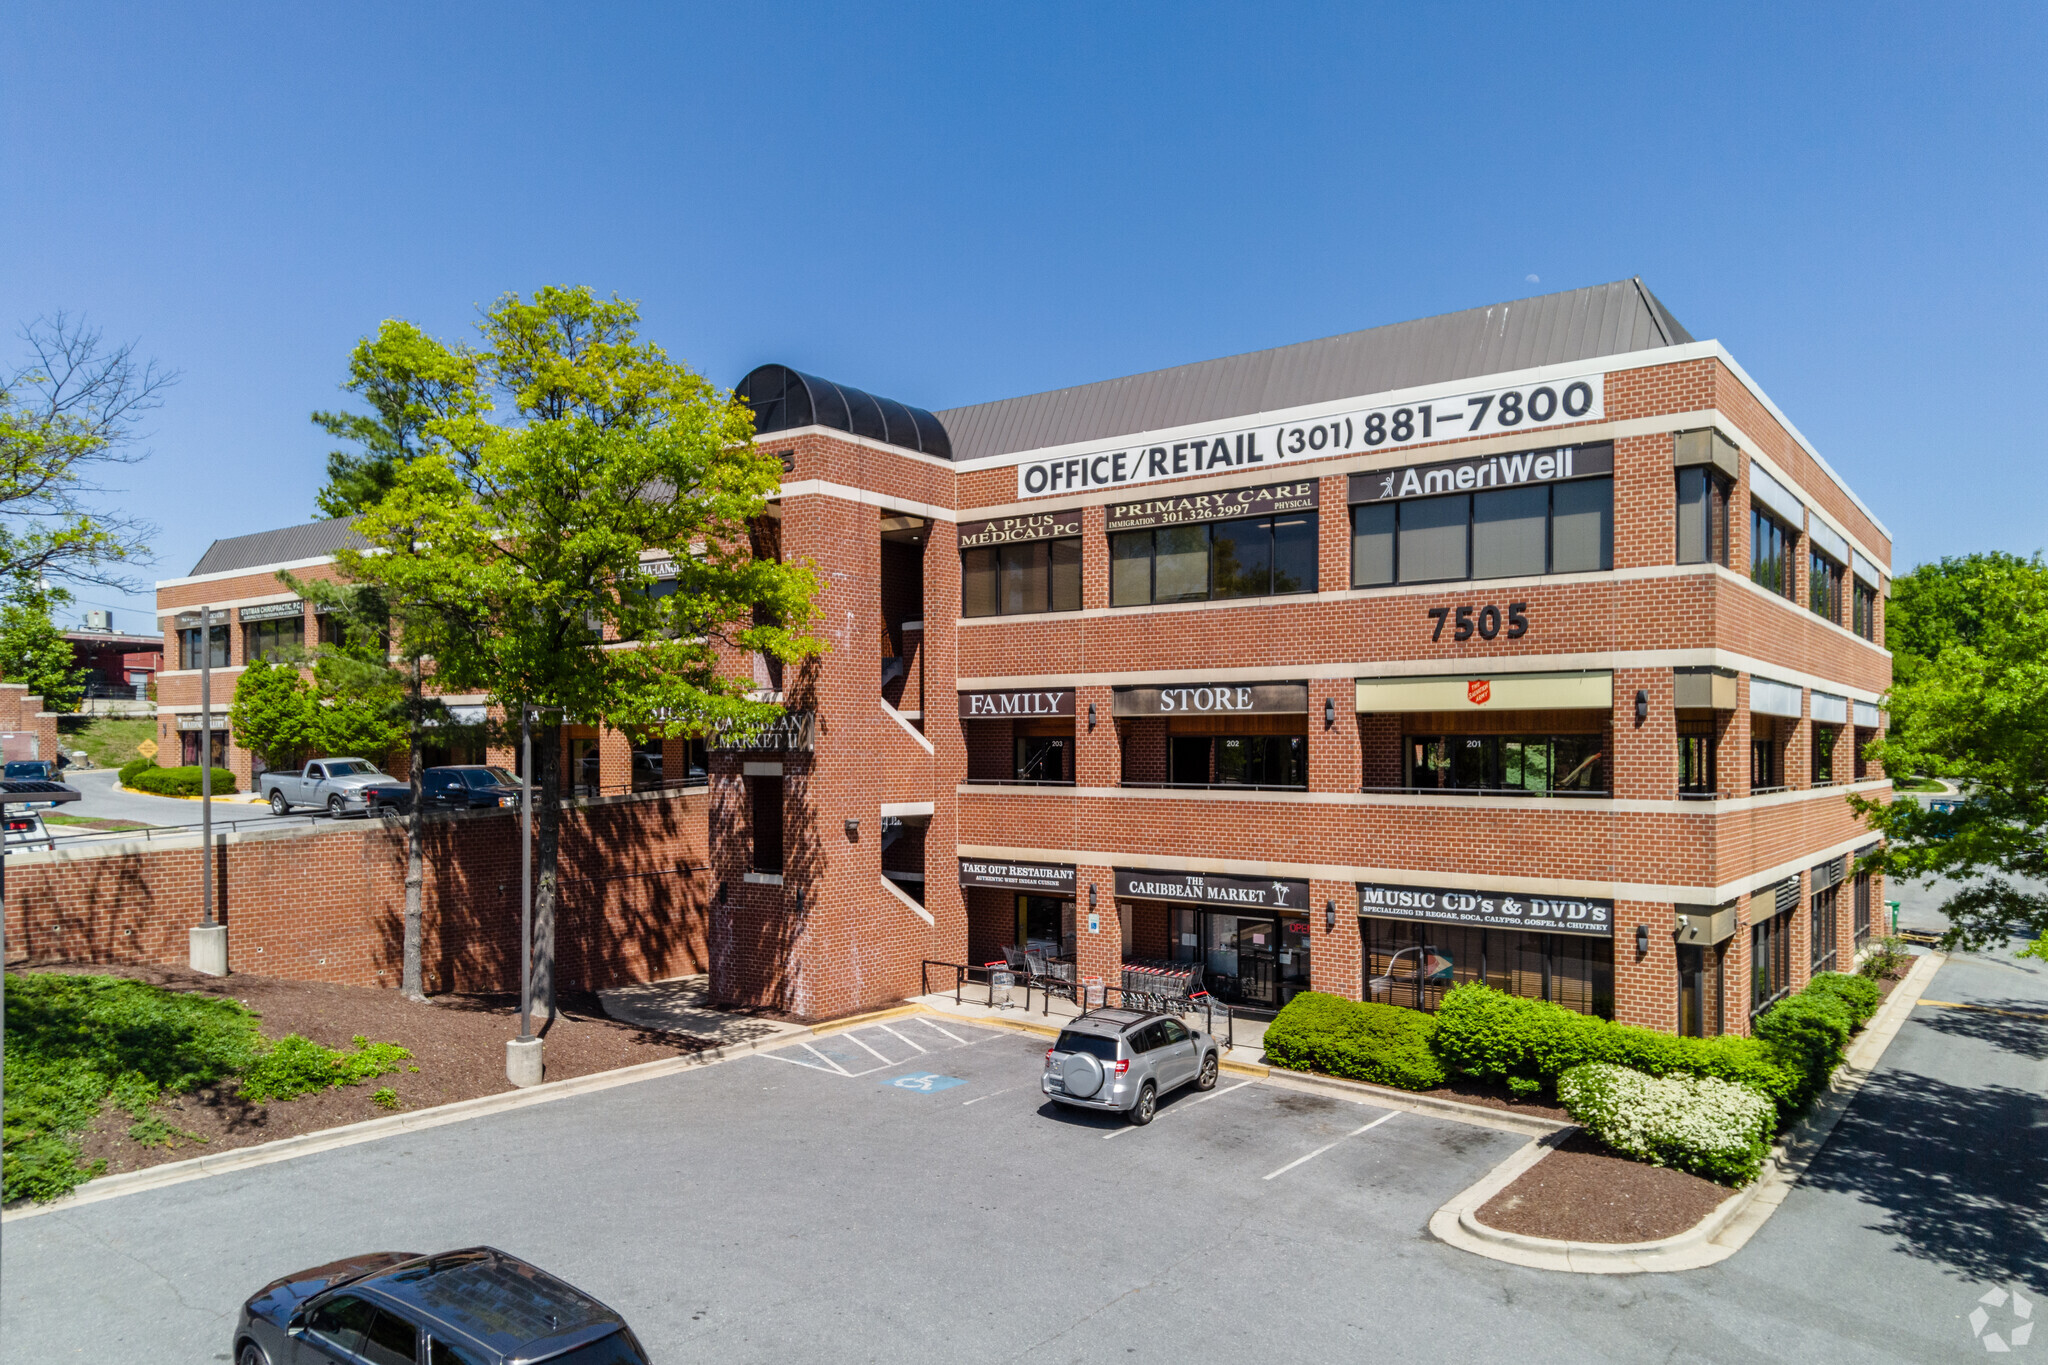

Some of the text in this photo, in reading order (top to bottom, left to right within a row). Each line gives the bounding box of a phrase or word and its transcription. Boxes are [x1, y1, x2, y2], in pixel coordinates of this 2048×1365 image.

[1024, 381, 1594, 494] OFFICE/RETAIL (301) 881-7800
[1399, 447, 1573, 497] AmeriWell
[1114, 483, 1312, 518] PRIMARY CARE
[984, 514, 1054, 533] A PLUS
[1108, 498, 1313, 529] IMMIGRATION 301.326.2997 PHYSICAL
[961, 522, 1079, 546] MEDICAL PC
[1428, 602, 1529, 643] 7505
[969, 692, 1064, 715] FAMILY
[1160, 687, 1254, 711] STORE
[719, 733, 783, 748] MARKET
[1051, 740, 1063, 748] 203
[1226, 740, 1240, 748] 202
[1466, 740, 1481, 748] 201
[962, 863, 1075, 880] TAKE OUT RESTAURANT
[975, 875, 1004, 883] AUTHENTIC
[1186, 876, 1205, 886] THE
[1129, 881, 1266, 903] CARIBBEAN MARKET
[1363, 887, 1436, 909] MUSIC
[1501, 897, 1523, 916] &
[1363, 905, 1414, 916] SPECIALIZING
[1425, 911, 1460, 920] REGGAE,
[1484, 915, 1523, 925] CALYPSO,
[1524, 918, 1556, 928] GOSPEL
[1566, 922, 1608, 931] CHUTNEY
